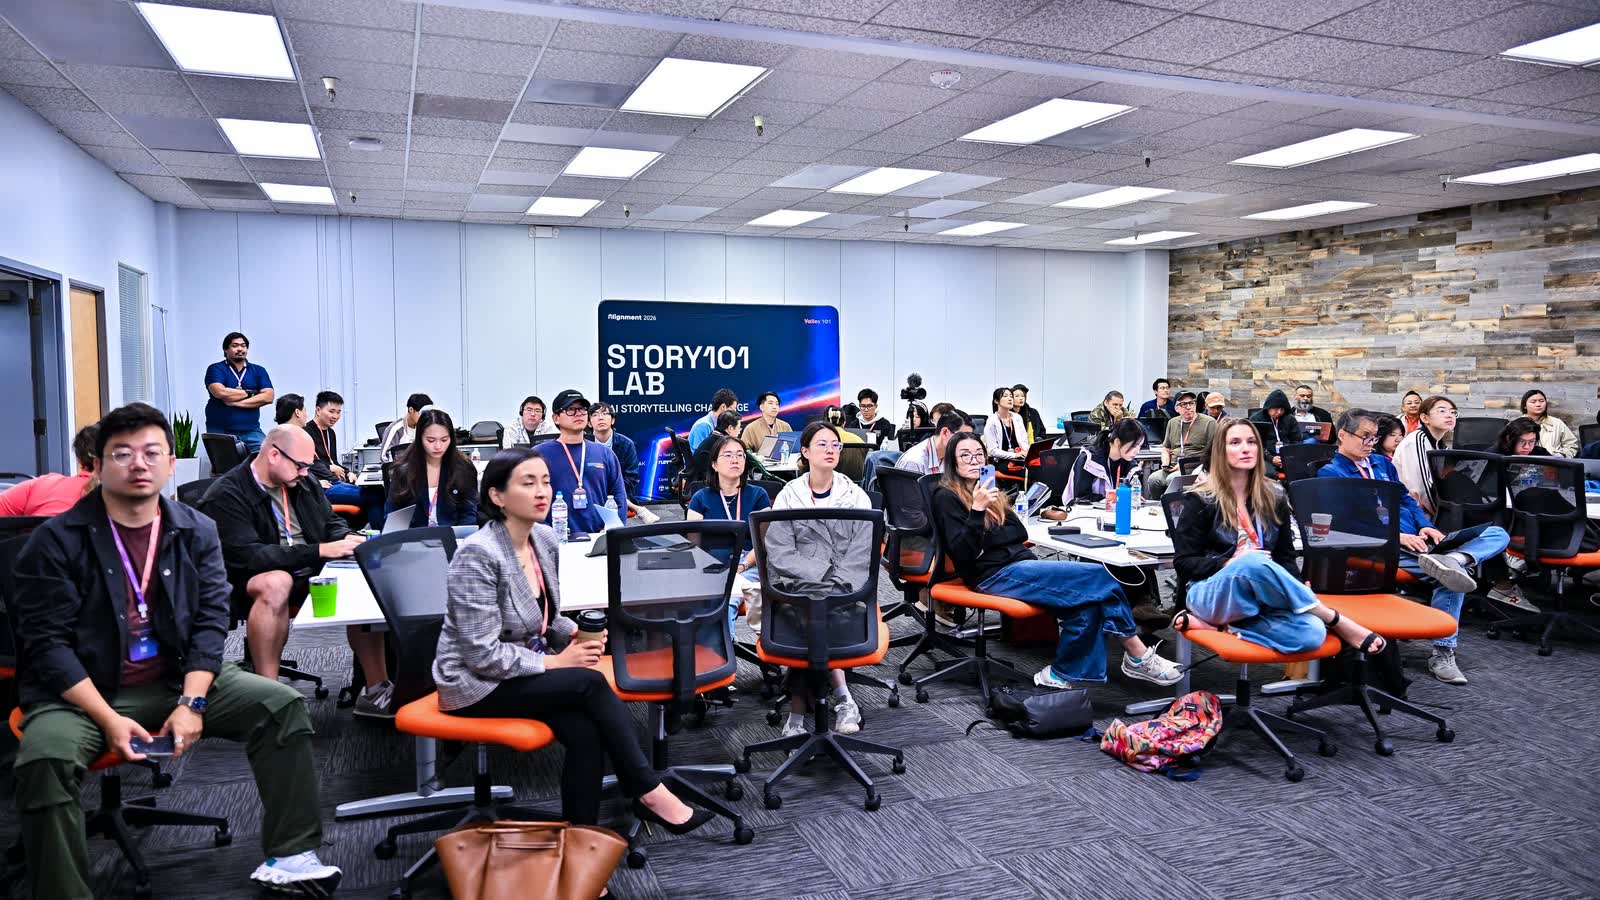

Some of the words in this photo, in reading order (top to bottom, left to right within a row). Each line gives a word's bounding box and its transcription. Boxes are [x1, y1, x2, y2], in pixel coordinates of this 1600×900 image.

[607, 313, 642, 321] Alignment
[607, 344, 749, 369] STORY101
[608, 372, 665, 396] LAB
[621, 404, 692, 413] STORYTELLING
[694, 403, 749, 412] CHAGE
